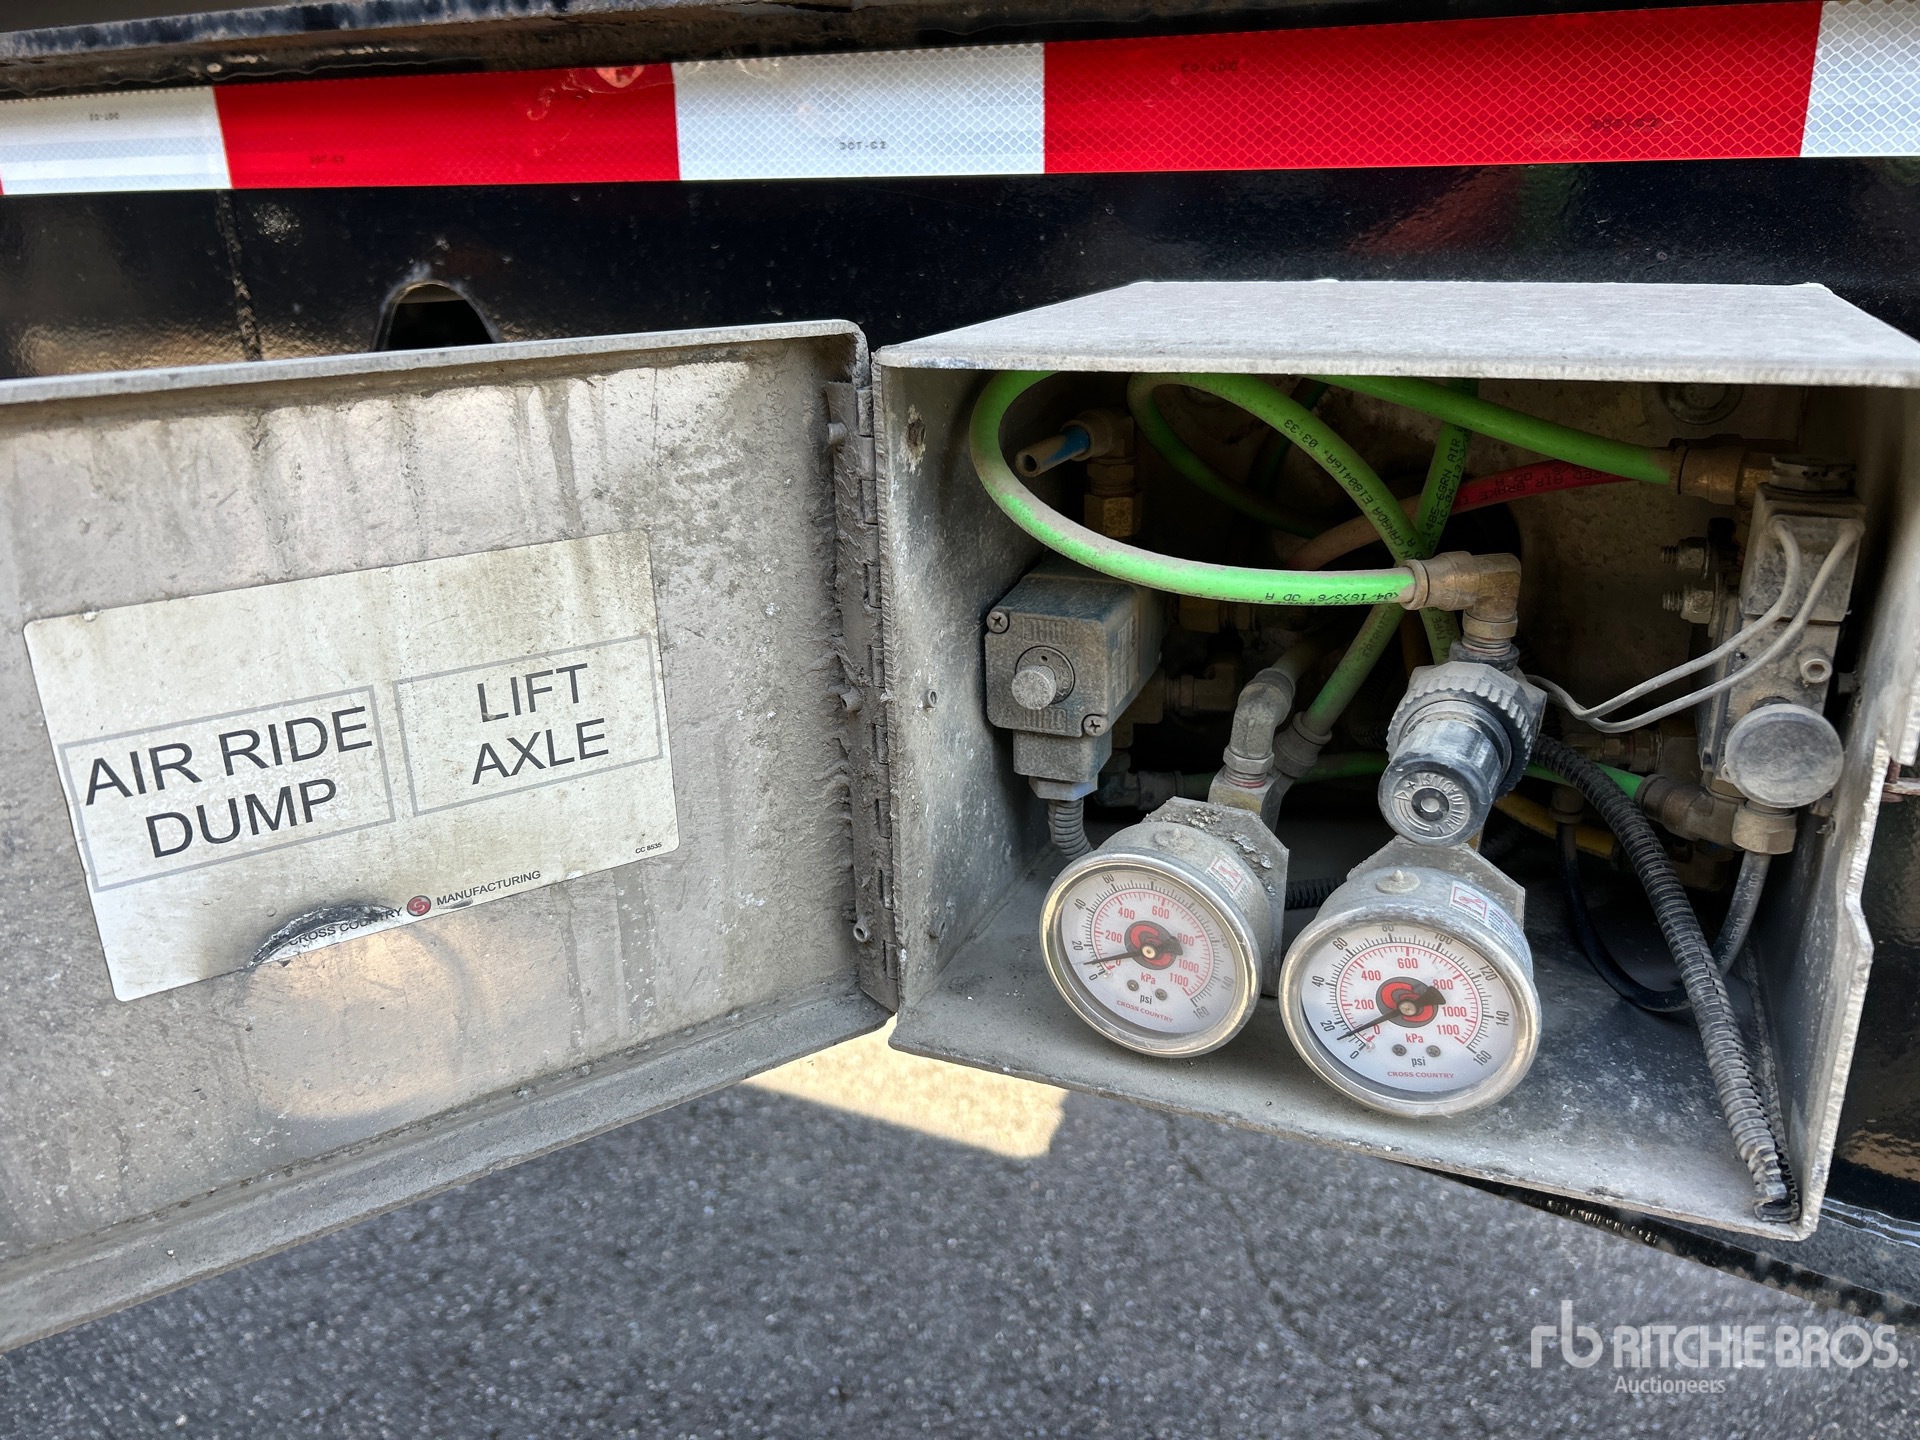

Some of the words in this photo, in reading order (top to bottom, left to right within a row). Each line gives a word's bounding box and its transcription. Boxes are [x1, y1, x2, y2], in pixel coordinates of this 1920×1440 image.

[1284, 419, 1318, 449] 03:33
[1447, 438, 1461, 463] AIR
[1535, 475, 1564, 487] AIR
[1480, 482, 1525, 500] BRAKE
[1372, 506, 1404, 547] CANADA
[477, 663, 589, 723] LIFT
[85, 742, 202, 806] AIR
[219, 705, 374, 777] RIDE
[471, 717, 608, 786] AXLE
[146, 778, 337, 859] DUMP
[635, 846, 646, 854] CC
[646, 842, 663, 852] 8535
[289, 926, 336, 947] CROSS
[436, 870, 541, 907] MANUFACTURING
[1074, 898, 1087, 911] 40
[1117, 906, 1136, 920] 400
[1151, 905, 1170, 919] 600
[1105, 930, 1123, 944] 200
[1332, 937, 1349, 951] 60
[1071, 940, 1084, 951] 20
[1178, 958, 1200, 973] 1000
[1397, 957, 1419, 969] 600
[1088, 973, 1099, 981] 0
[1140, 972, 1156, 985] kPa
[1169, 972, 1189, 987] 1100
[1361, 970, 1382, 981] 400
[1479, 965, 1498, 981] 120
[1311, 975, 1325, 988] 40
[1432, 979, 1454, 990] 800
[1139, 994, 1153, 1005] psi
[1354, 999, 1375, 1010] 200
[1116, 1000, 1139, 1011] CROSS
[1140, 1006, 1173, 1022] COUNTRY
[1193, 1005, 1210, 1020] 160
[1442, 1006, 1467, 1018] 1000
[1320, 1019, 1335, 1032] 20
[1496, 1010, 1510, 1027] 140
[1436, 1024, 1460, 1036] 1100
[1405, 1033, 1424, 1044] kPa
[1349, 1050, 1360, 1060] 0
[1411, 1056, 1426, 1068] psi
[1473, 1050, 1493, 1066] 160
[1387, 1070, 1414, 1078] CROSS
[1415, 1071, 1455, 1079] COUNTRY
